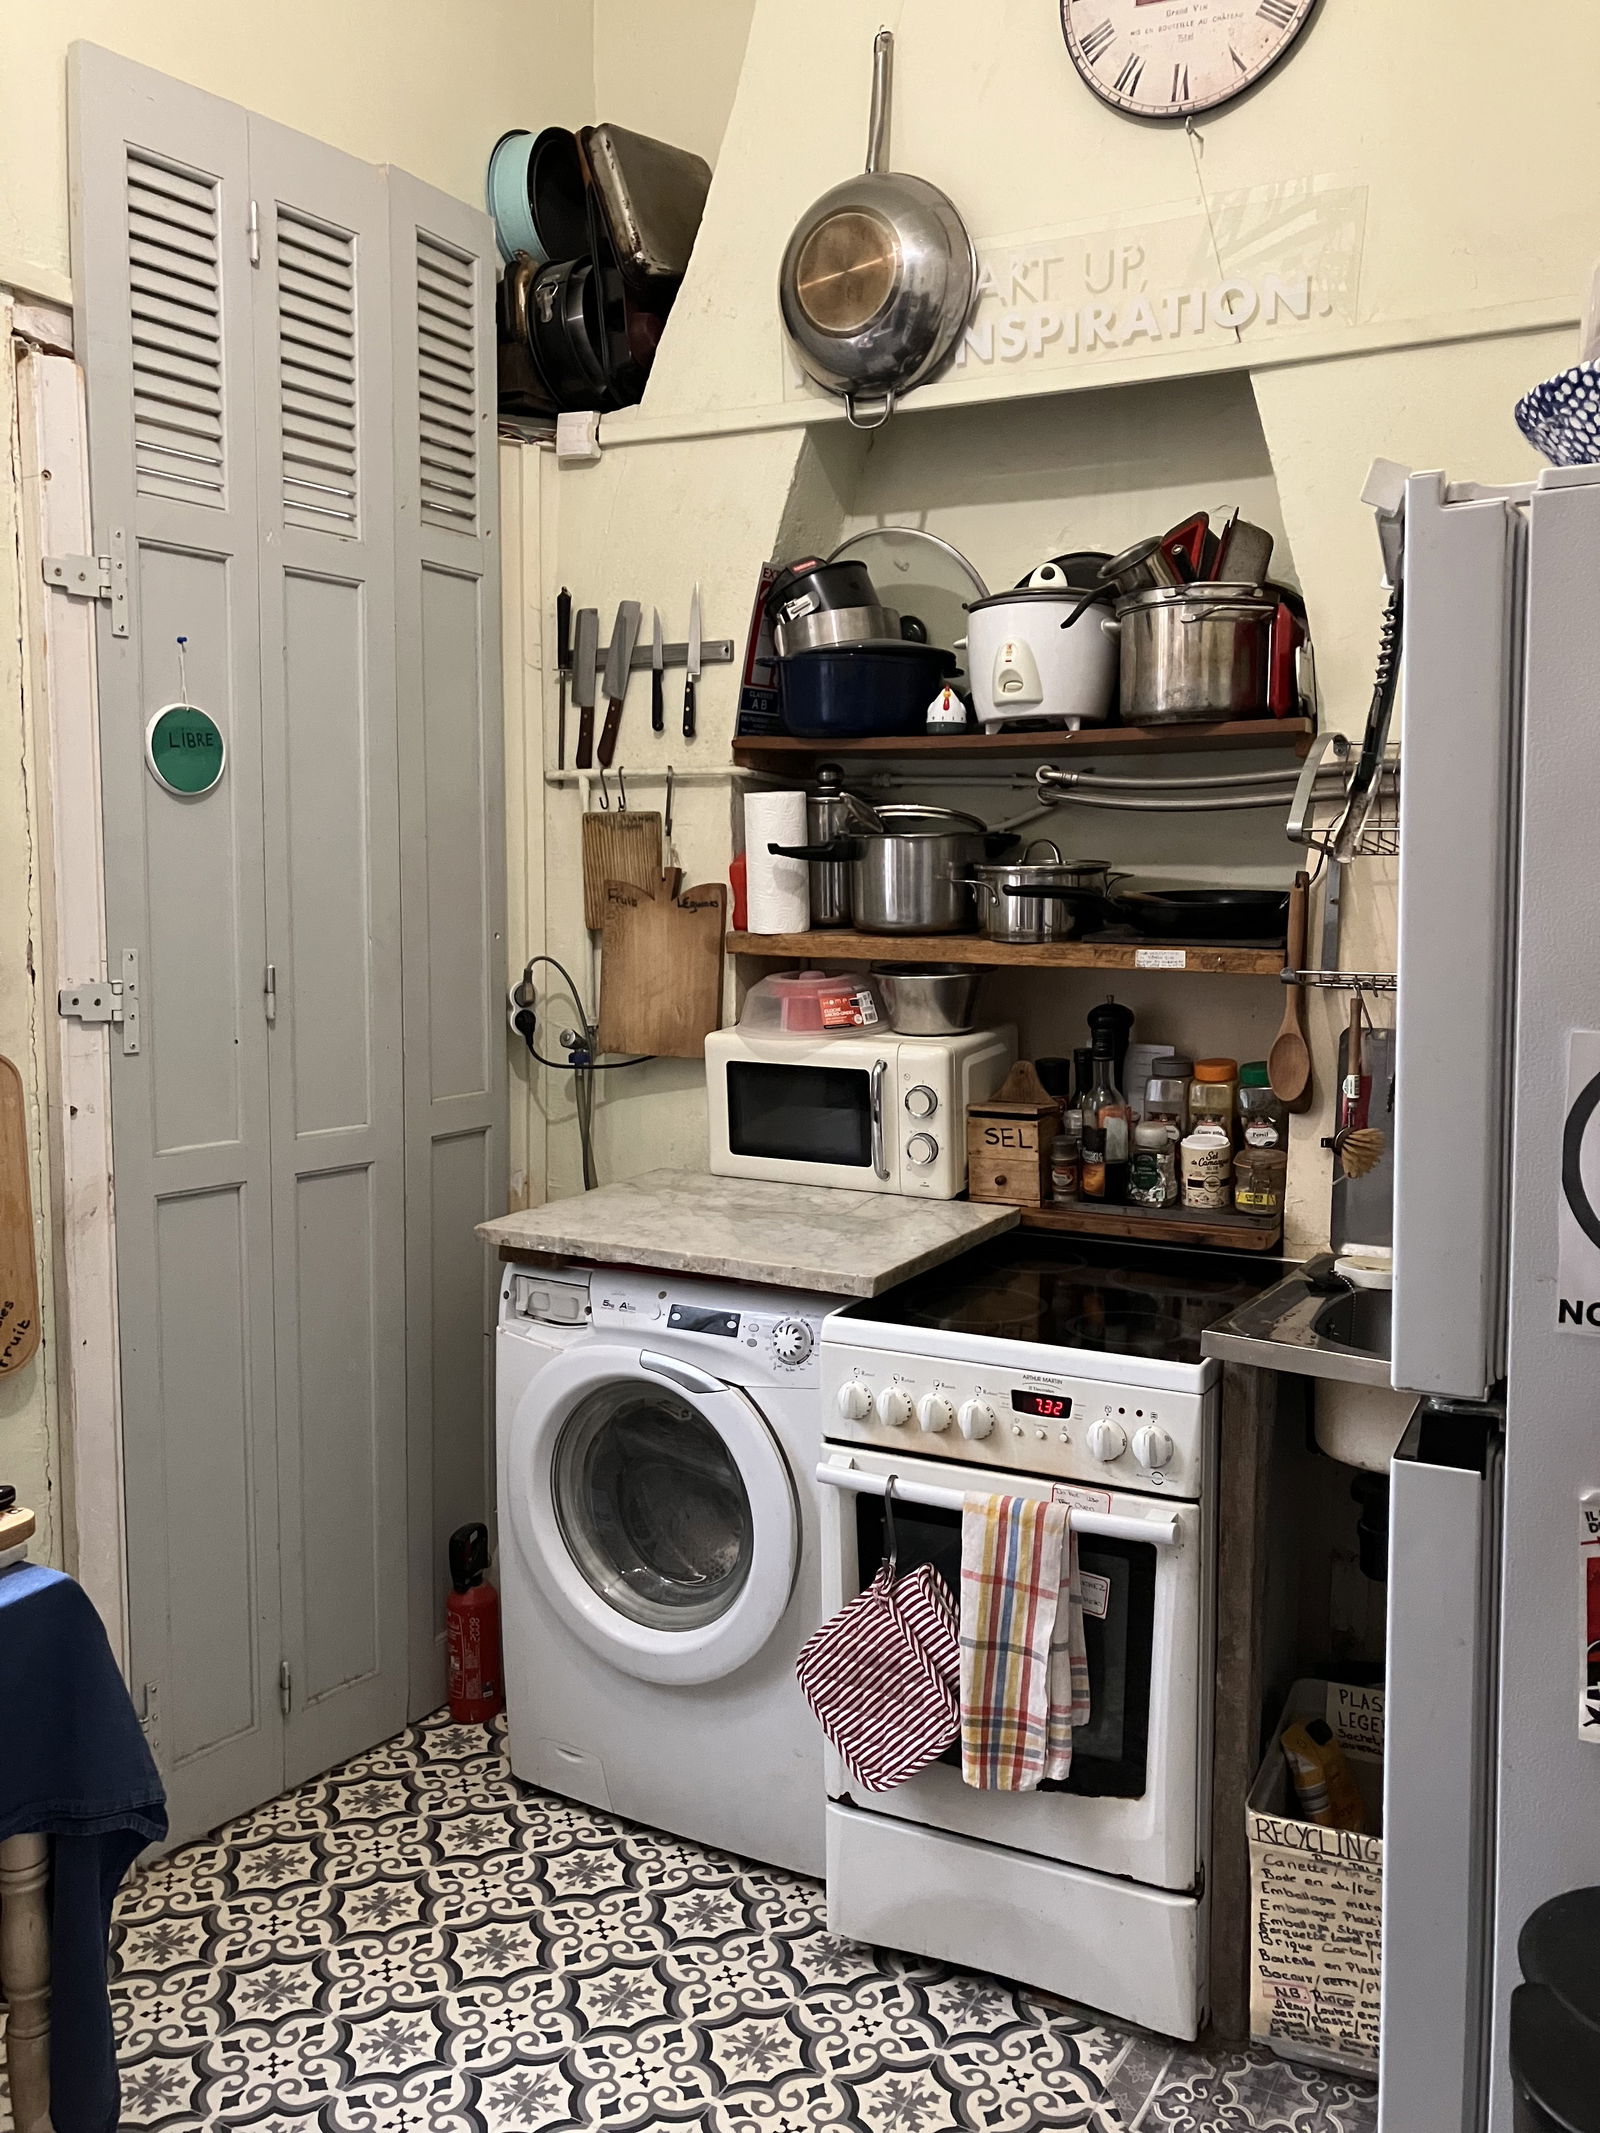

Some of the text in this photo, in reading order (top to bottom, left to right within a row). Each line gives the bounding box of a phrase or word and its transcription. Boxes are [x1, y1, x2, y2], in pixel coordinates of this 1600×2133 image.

[169, 728, 214, 748] LIBRE
[984, 1127, 1033, 1149] SEL
[1588, 1521, 1600, 1533] D
[1338, 1711, 1385, 1734] LEGE
[1255, 1818, 1381, 1861] RECYCLING
